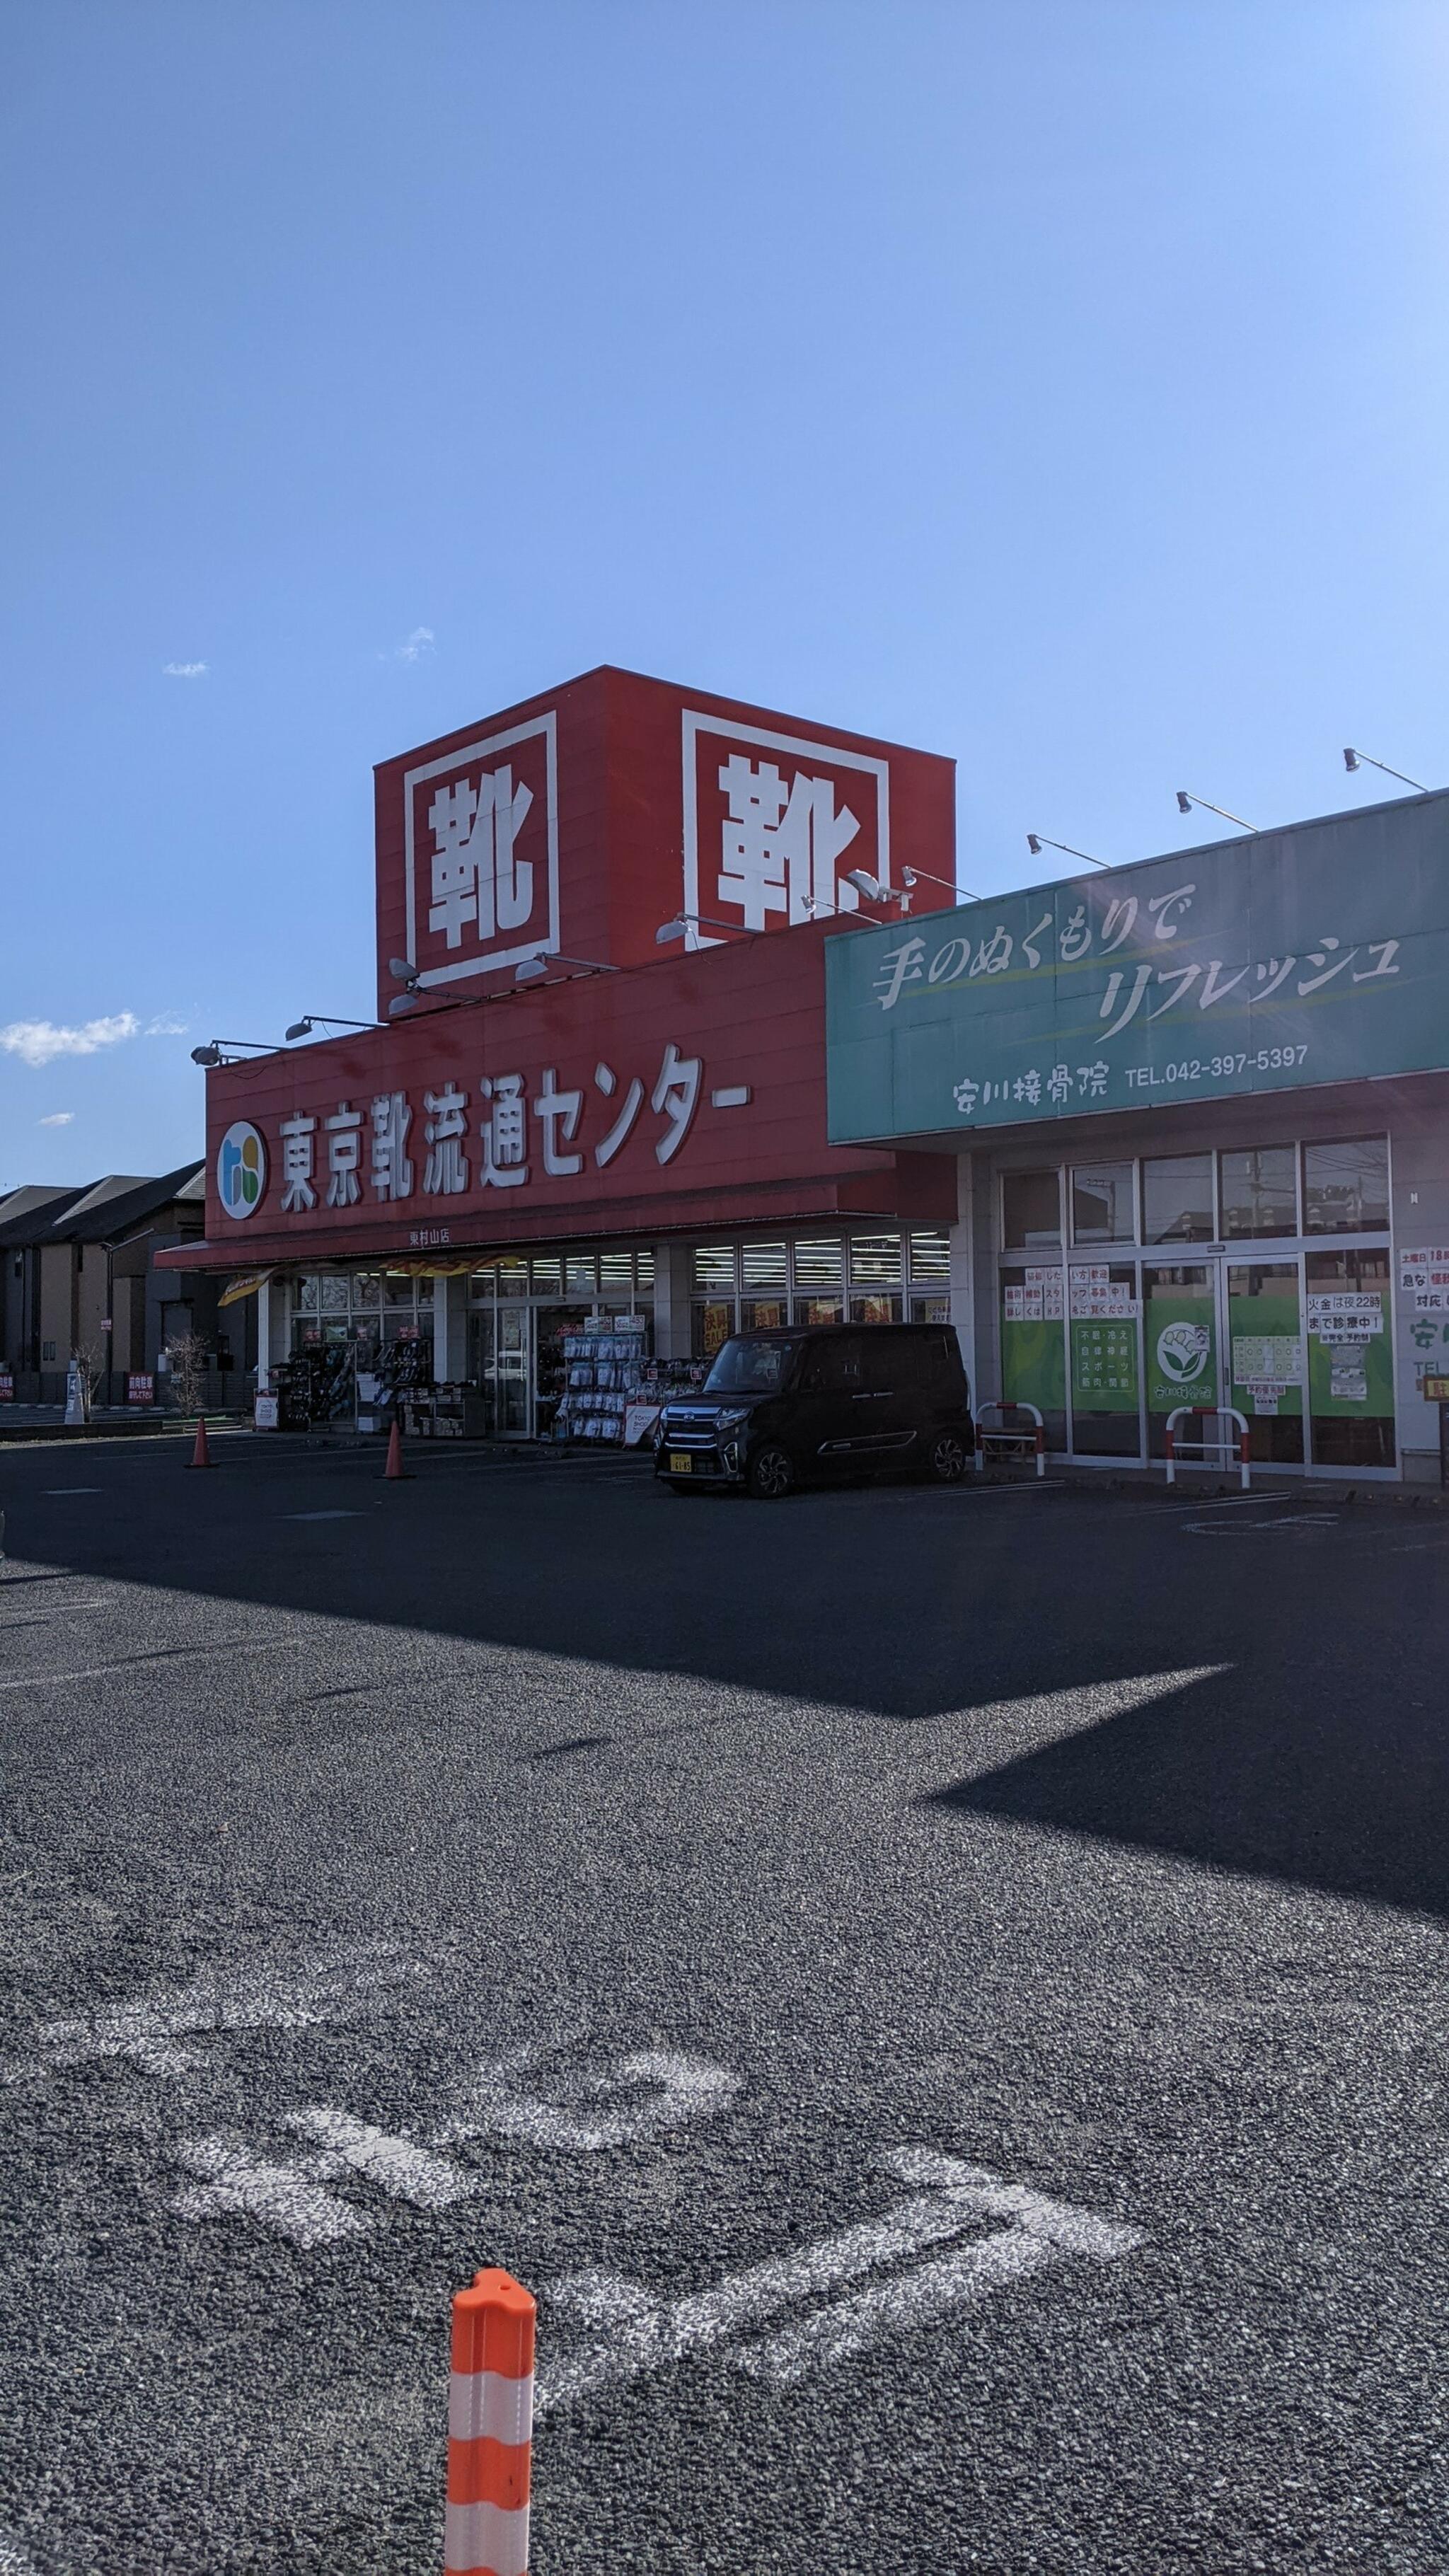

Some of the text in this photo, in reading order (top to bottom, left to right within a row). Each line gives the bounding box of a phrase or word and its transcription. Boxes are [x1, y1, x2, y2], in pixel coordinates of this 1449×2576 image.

[428, 763, 534, 950] 靴
[718, 753, 860, 930] 靴
[872, 884, 1196, 1010] 手のぬくもりで
[1095, 937, 1401, 1044] リフレッシュ
[281, 1043, 751, 1213] 東京靴流通センター
[953, 1061, 1110, 1115] 安川接骨院
[409, 1228, 450, 1246] 東村山店
[1309, 1296, 1381, 1310] 火金は夜22時
[1410, 1318, 1449, 1349] 安
[1082, 1362, 1128, 1372] スポーツ
